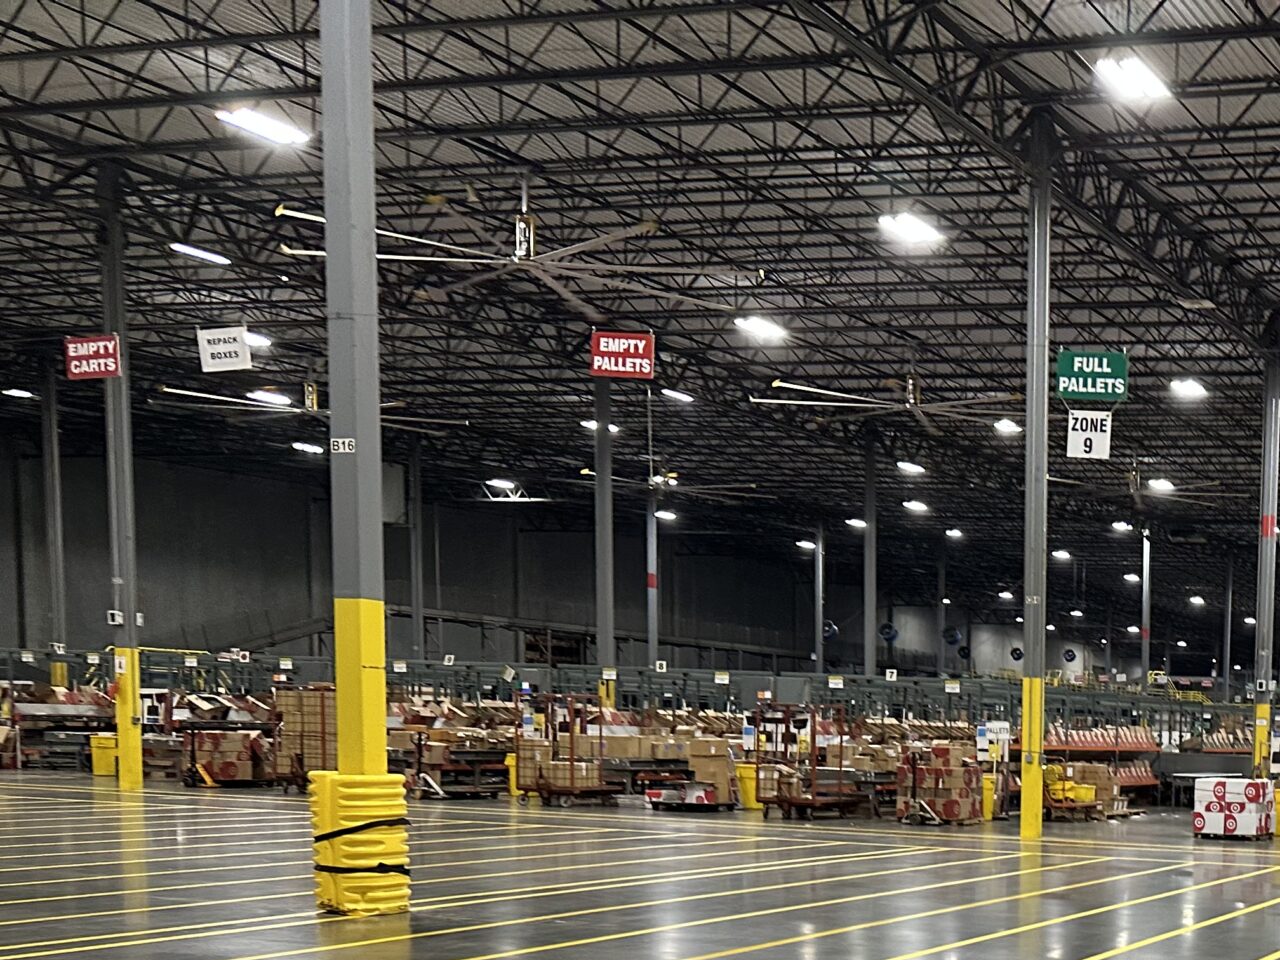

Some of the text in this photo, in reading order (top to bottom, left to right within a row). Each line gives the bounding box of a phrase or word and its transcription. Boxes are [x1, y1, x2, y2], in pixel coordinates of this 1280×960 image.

[67, 340, 116, 357] EMPTY
[207, 336, 238, 345] REPACK
[599, 337, 646, 354] EMPTY
[210, 350, 240, 360] BOXES
[70, 357, 117, 373] CARTS
[593, 355, 651, 374] PALLETS
[1073, 356, 1112, 373] FULL
[1059, 376, 1125, 394] PALLETS
[1071, 417, 1108, 433] ZONE
[332, 440, 354, 451] B16
[1083, 437, 1093, 454] 9
[888, 671, 894, 679] 7
